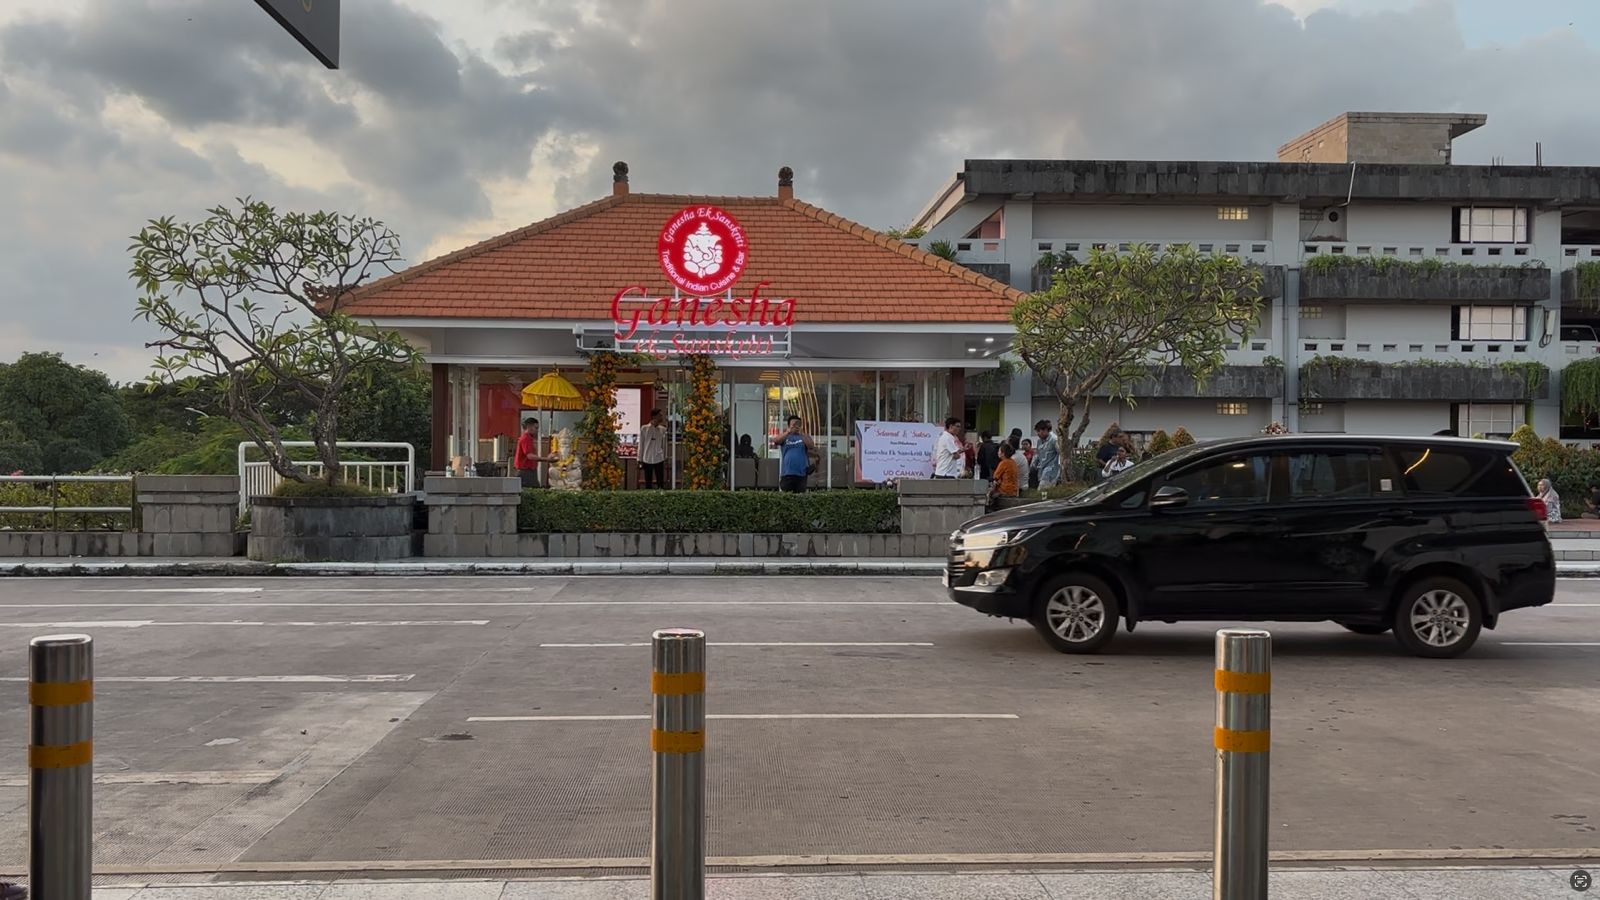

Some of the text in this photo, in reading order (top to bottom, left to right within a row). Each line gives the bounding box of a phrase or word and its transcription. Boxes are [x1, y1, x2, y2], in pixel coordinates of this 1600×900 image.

[664, 207, 746, 247] Ganesha Ek Sanskriti
[662, 249, 685, 285] Traditional
[685, 281, 709, 292] Indian
[709, 272, 736, 290] Cuisine
[735, 252, 745, 265] Bar
[610, 281, 797, 341] Ganesha
